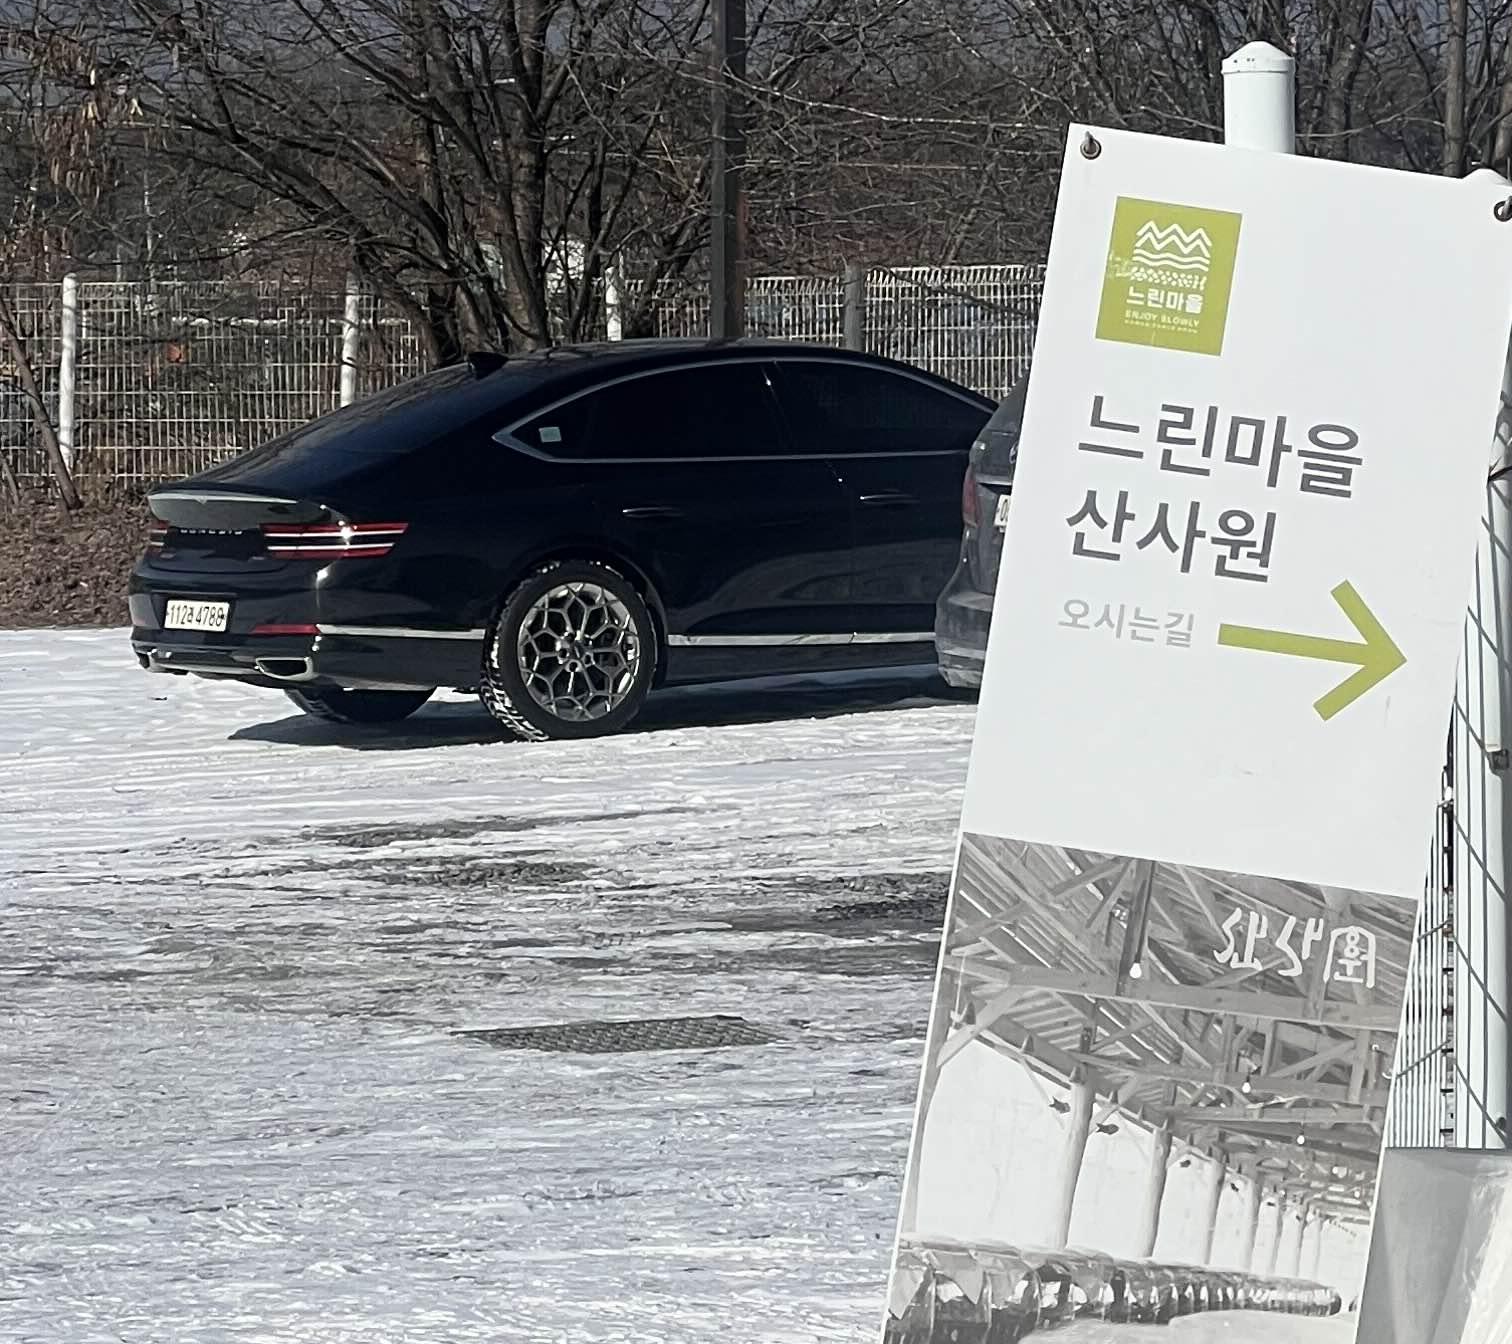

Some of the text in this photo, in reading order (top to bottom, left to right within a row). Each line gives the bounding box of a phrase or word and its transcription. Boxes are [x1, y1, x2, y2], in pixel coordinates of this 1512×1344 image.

[1126, 285, 1203, 314] 느린마을
[1078, 395, 1363, 499] 느린마을
[1066, 489, 1277, 583] 산사원
[1057, 599, 1196, 649] 오시는길
